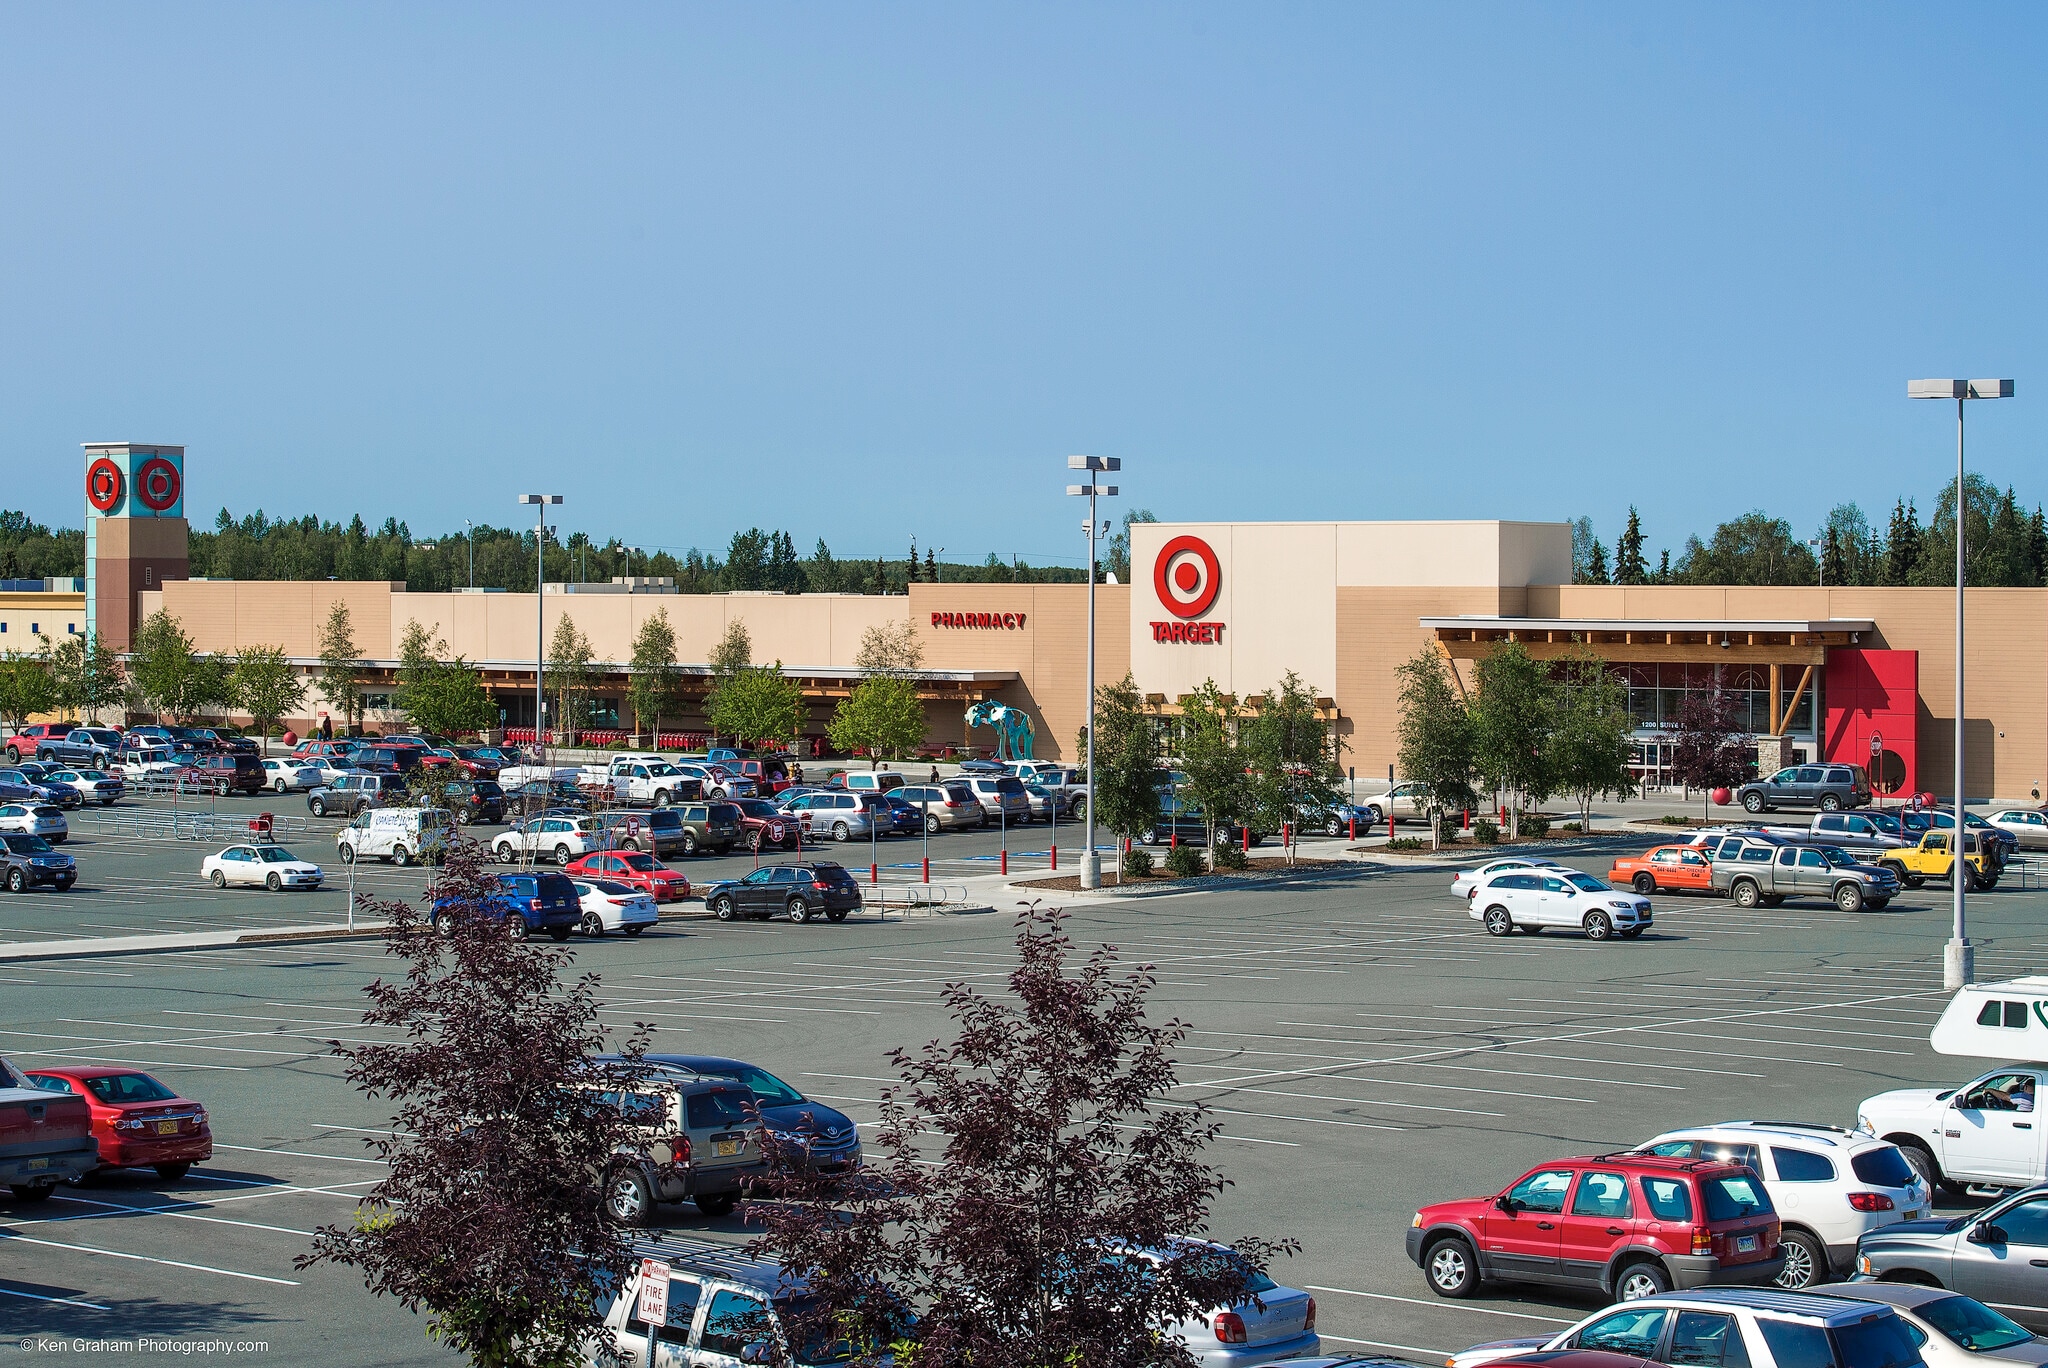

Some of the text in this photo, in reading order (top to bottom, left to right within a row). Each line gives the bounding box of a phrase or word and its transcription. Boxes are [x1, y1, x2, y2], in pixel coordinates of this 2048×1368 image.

[931, 612, 1026, 629] PHARMACY
[1149, 621, 1226, 643] TARGET
[643, 1261, 652, 1276] NO
[645, 1284, 663, 1300] FIRE
[642, 1300, 663, 1316] LANE
